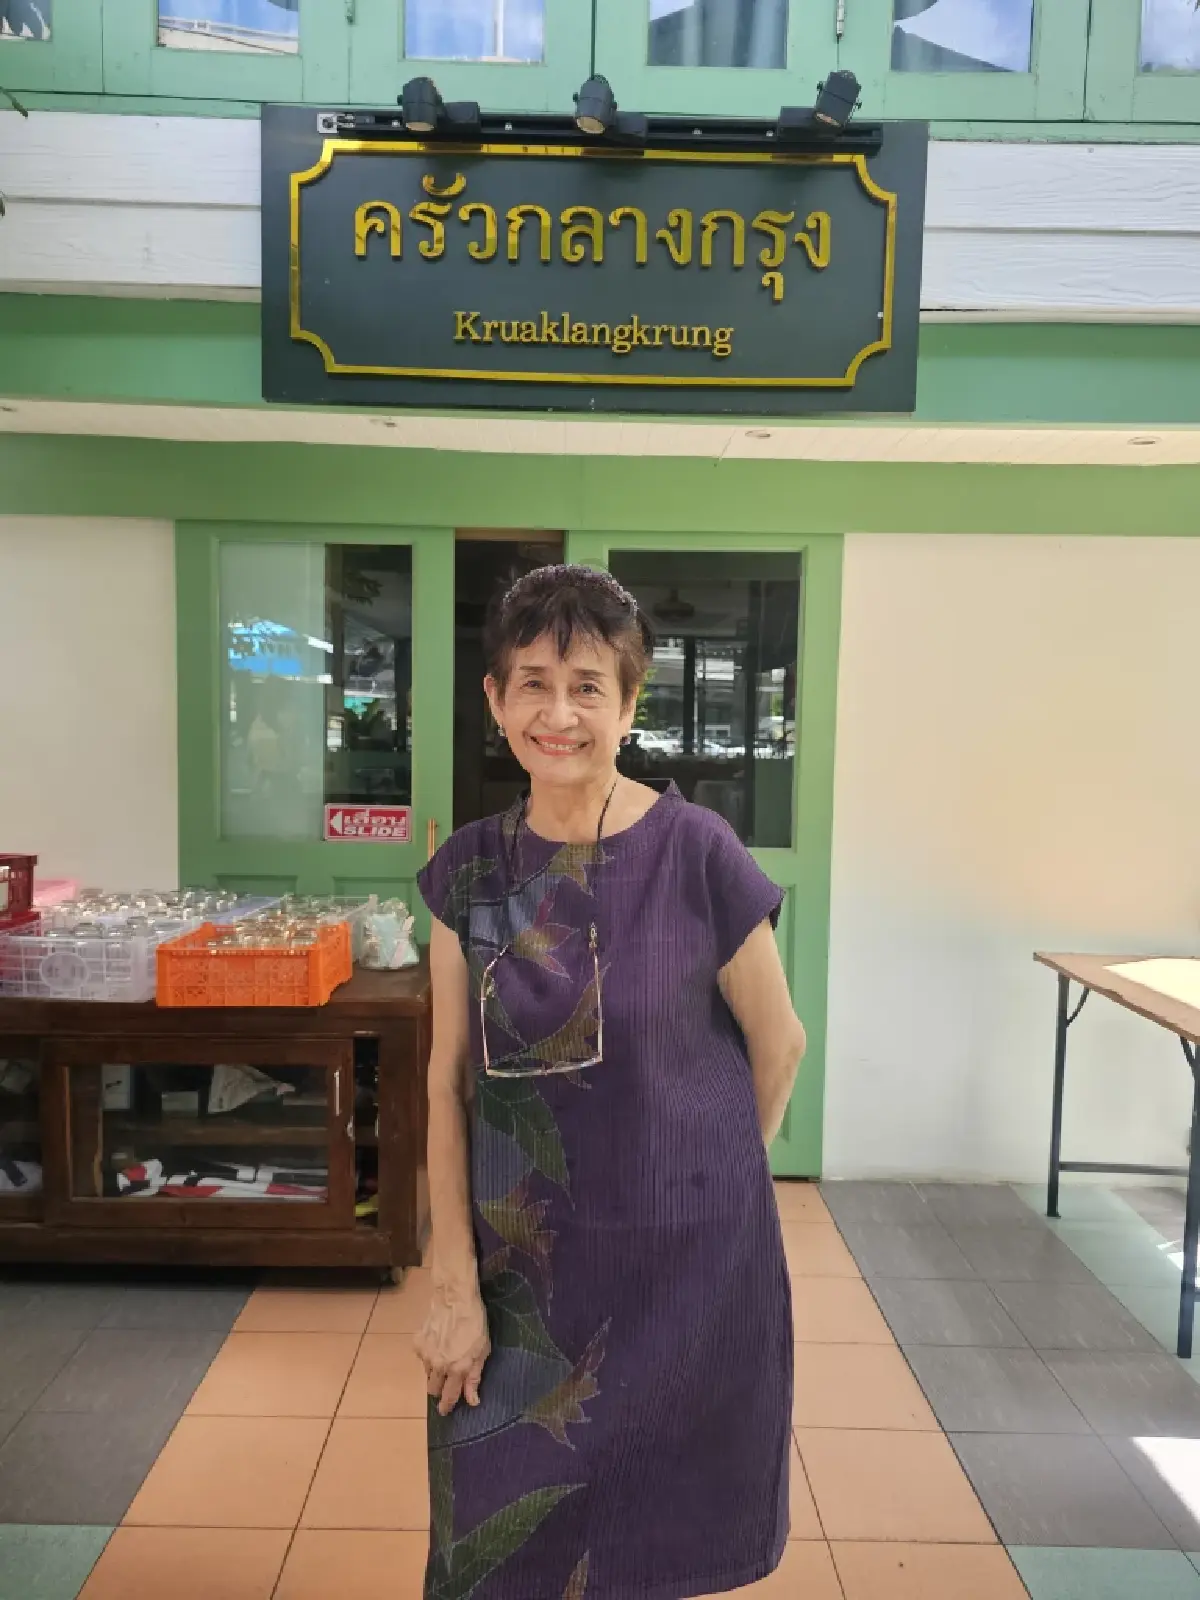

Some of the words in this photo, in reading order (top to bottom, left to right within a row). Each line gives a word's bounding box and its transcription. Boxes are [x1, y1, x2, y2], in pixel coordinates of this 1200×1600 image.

[353, 172, 832, 301] ครัวกลางกรุง
[453, 310, 734, 356] Kruaklangkrung
[343, 826, 406, 837] SLIDE
